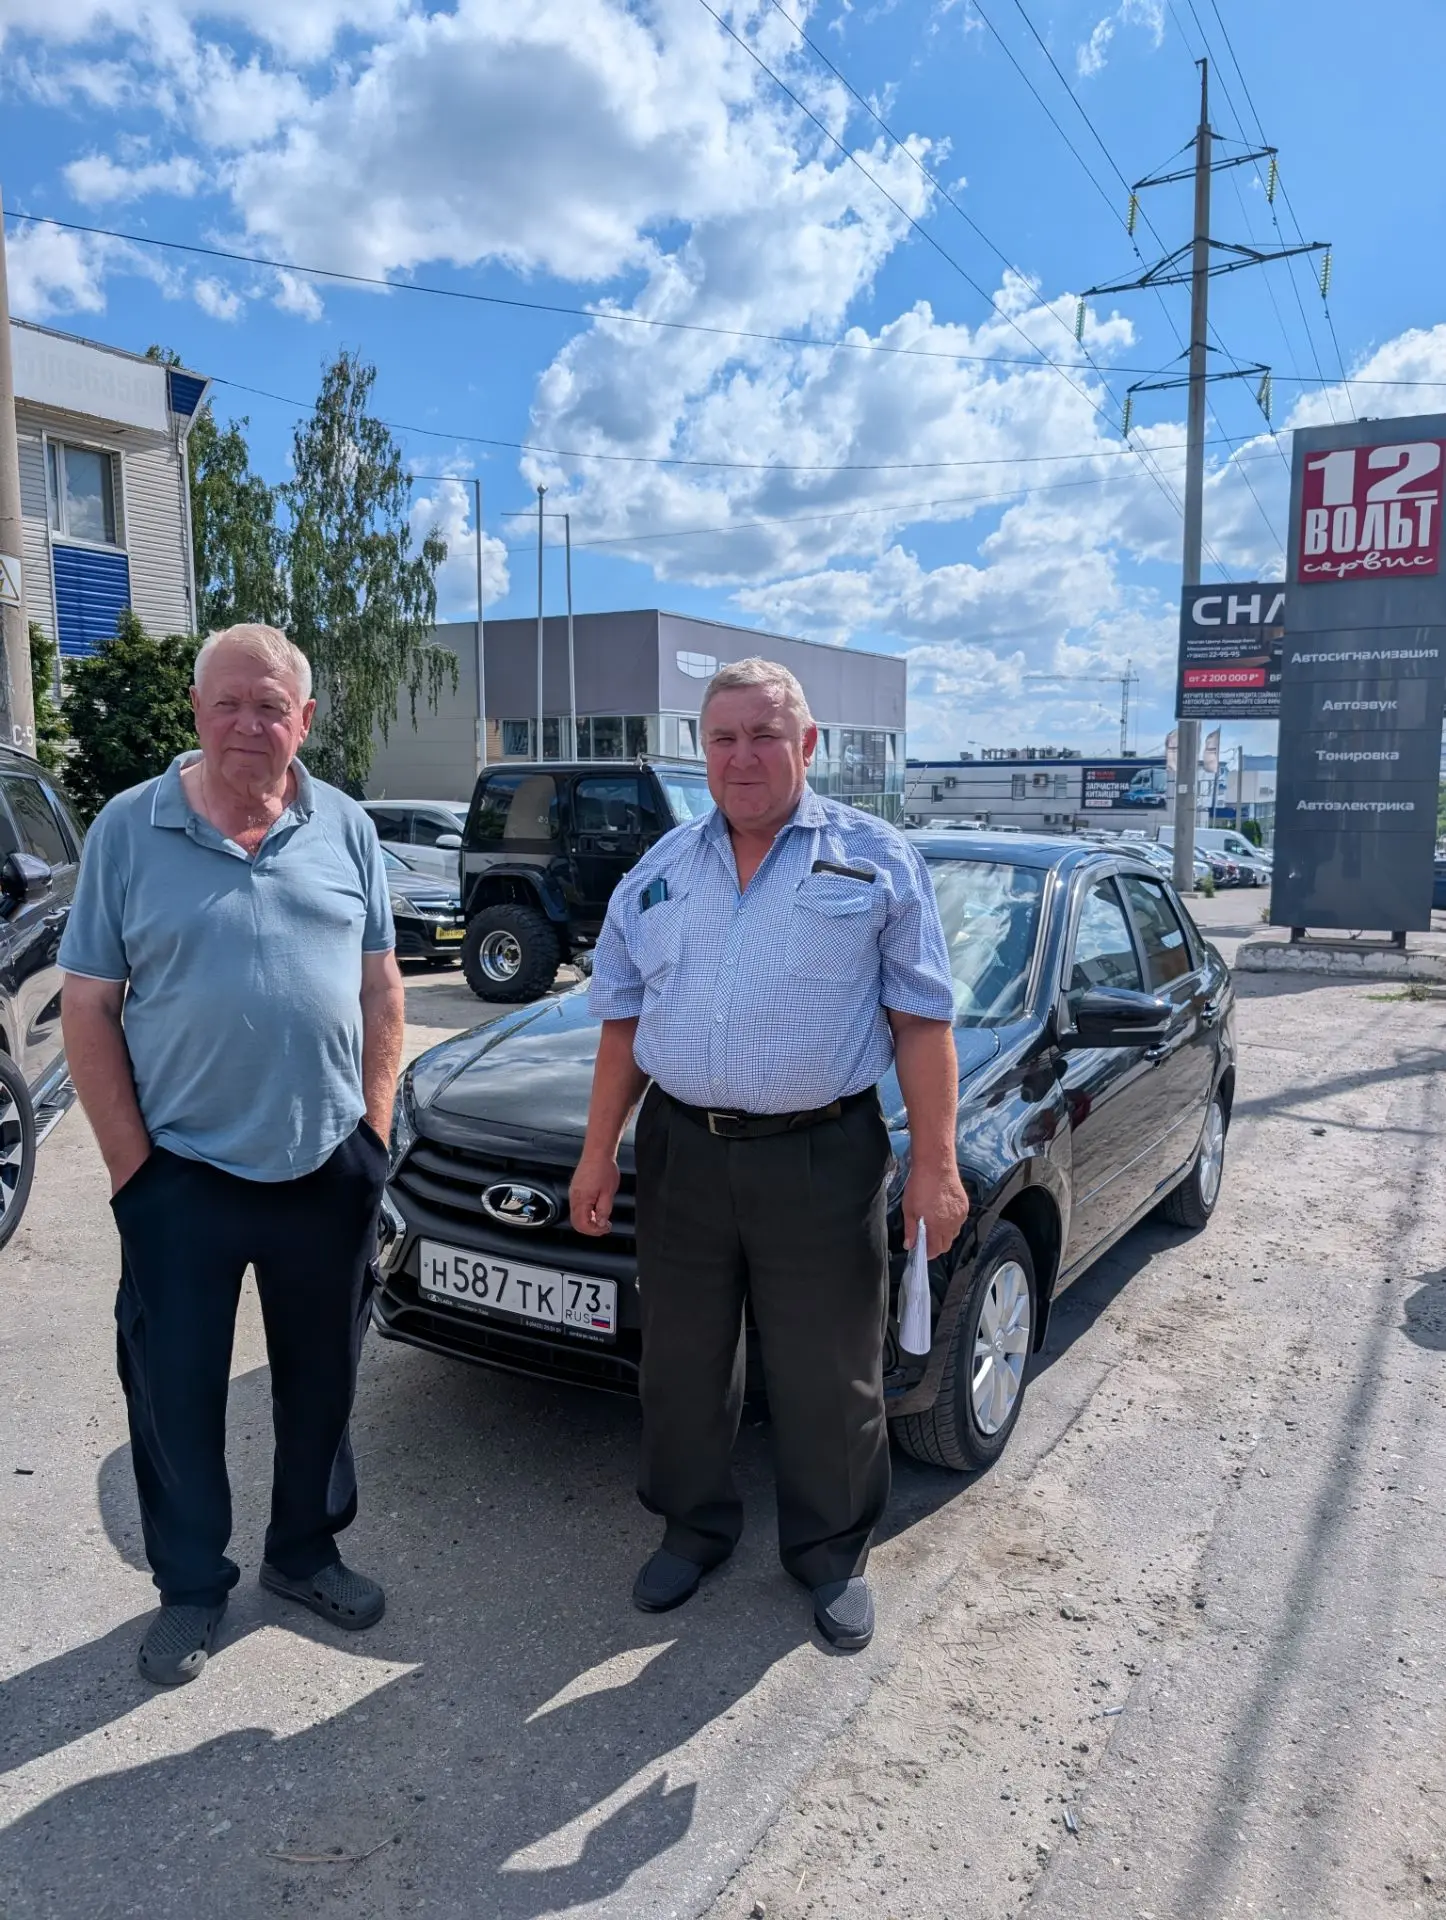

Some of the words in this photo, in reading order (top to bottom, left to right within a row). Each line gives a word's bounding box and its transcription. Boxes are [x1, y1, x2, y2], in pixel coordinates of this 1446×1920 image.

[1308, 442, 1441, 506] 12
[1304, 498, 1438, 555] ВОЛЬТ
[1303, 551, 1433, 578] сервис
[1291, 649, 1439, 663] Автосигнализация
[1201, 674, 1207, 682] 2
[1209, 674, 1227, 682] 200
[1228, 674, 1248, 682] 000
[1322, 699, 1398, 712] Автозвук
[1315, 750, 1400, 762] Тонировка
[1085, 782, 1119, 790] ЗАПЧАСТИ
[1120, 782, 1130, 790] НА
[1296, 800, 1415, 813] Автоэлектрика
[432, 1256, 554, 1315] Н587ТК
[567, 1280, 601, 1313] 73
[565, 1309, 591, 1324] RUS
